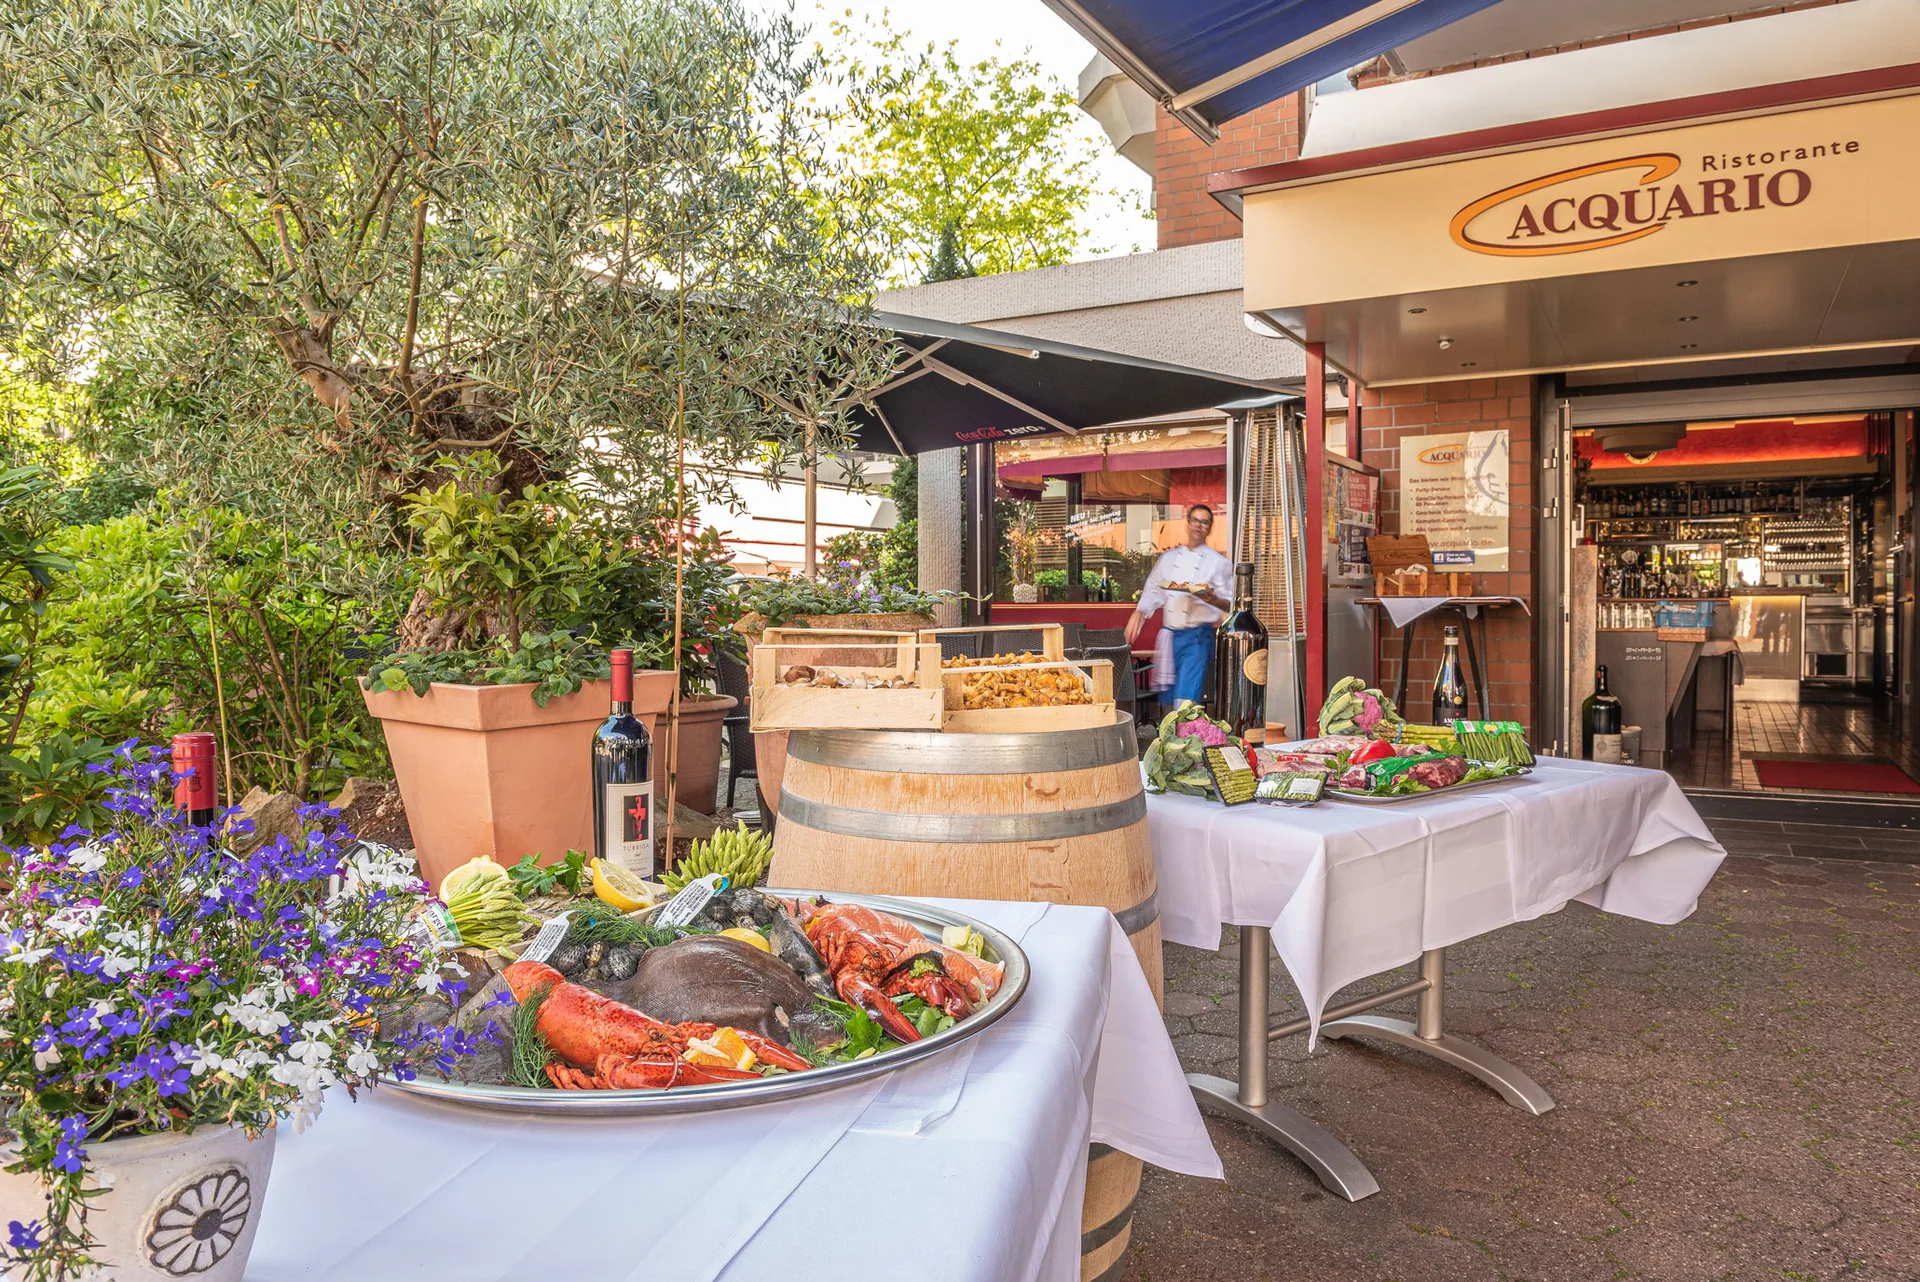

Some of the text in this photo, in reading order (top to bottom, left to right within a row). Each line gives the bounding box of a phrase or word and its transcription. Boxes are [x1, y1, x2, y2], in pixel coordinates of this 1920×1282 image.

[1702, 139, 1860, 172] Ristorante
[1507, 168, 1812, 239] ACQUARIO
[1004, 425, 1039, 435] zero
[1430, 449, 1486, 461] ACQUARIO
[1070, 512, 1085, 523] NEU
